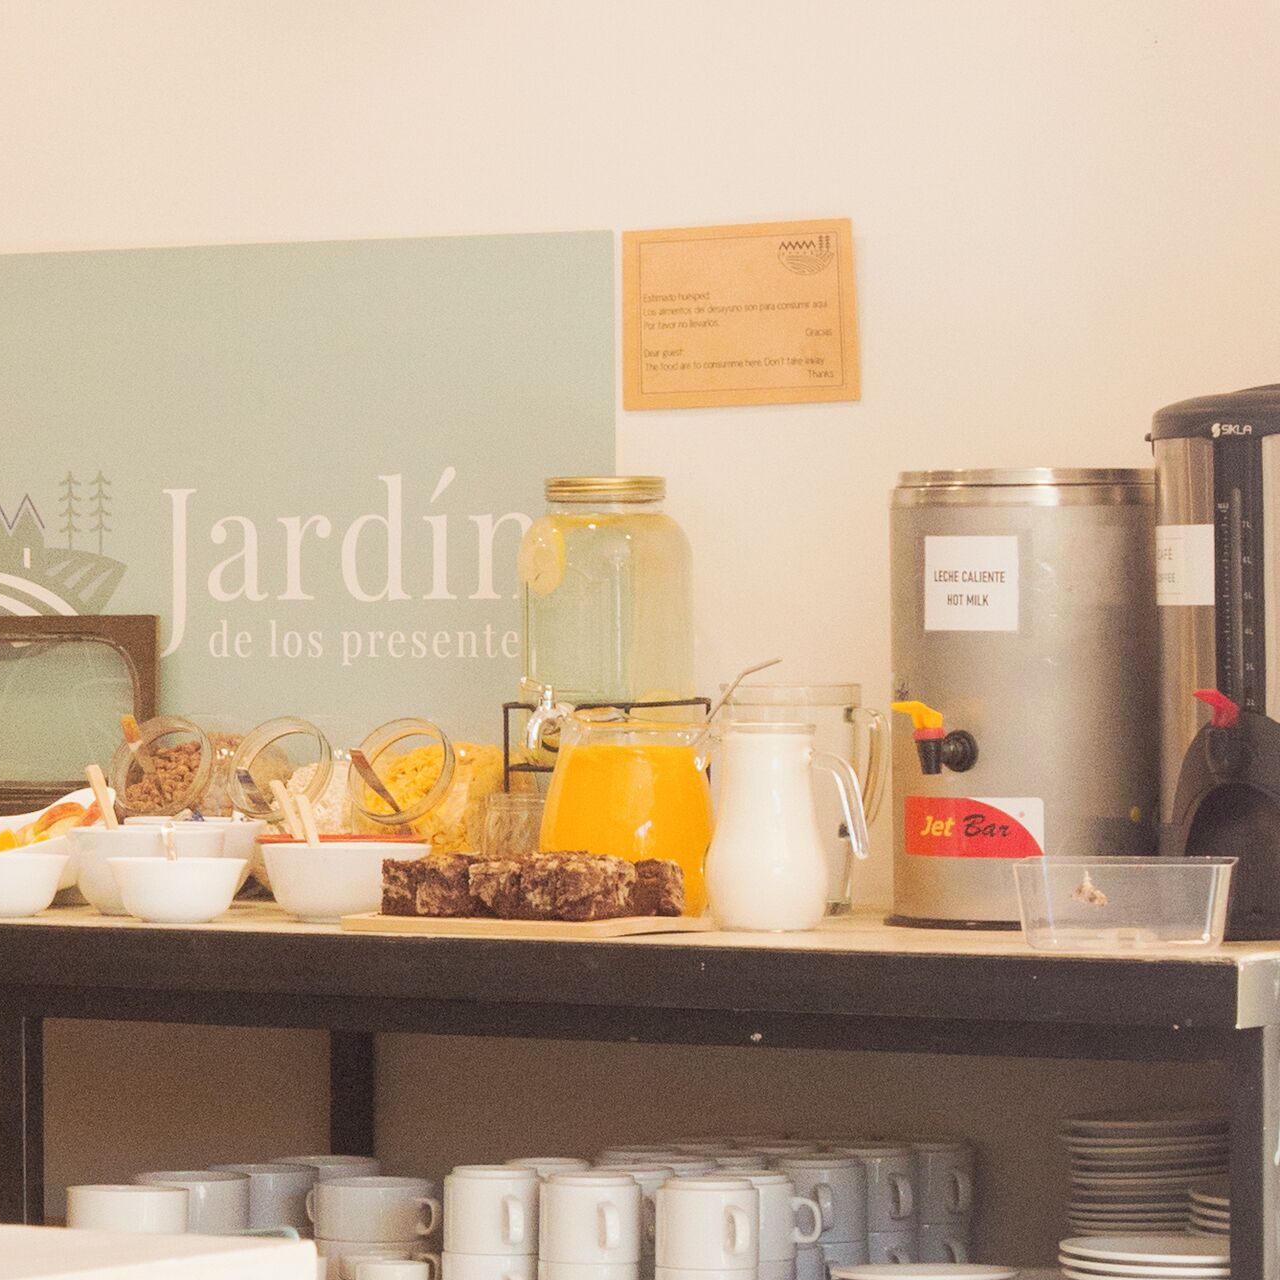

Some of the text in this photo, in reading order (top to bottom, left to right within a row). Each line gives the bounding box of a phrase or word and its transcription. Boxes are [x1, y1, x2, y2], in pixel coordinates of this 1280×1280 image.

[161, 466, 534, 659] Jardín
[933, 570, 1006, 584] LECHE CALIENTE
[947, 593, 989, 607] HOT MILK
[208, 620, 520, 666] de los presente
[920, 813, 1010, 838] Jet Bar
